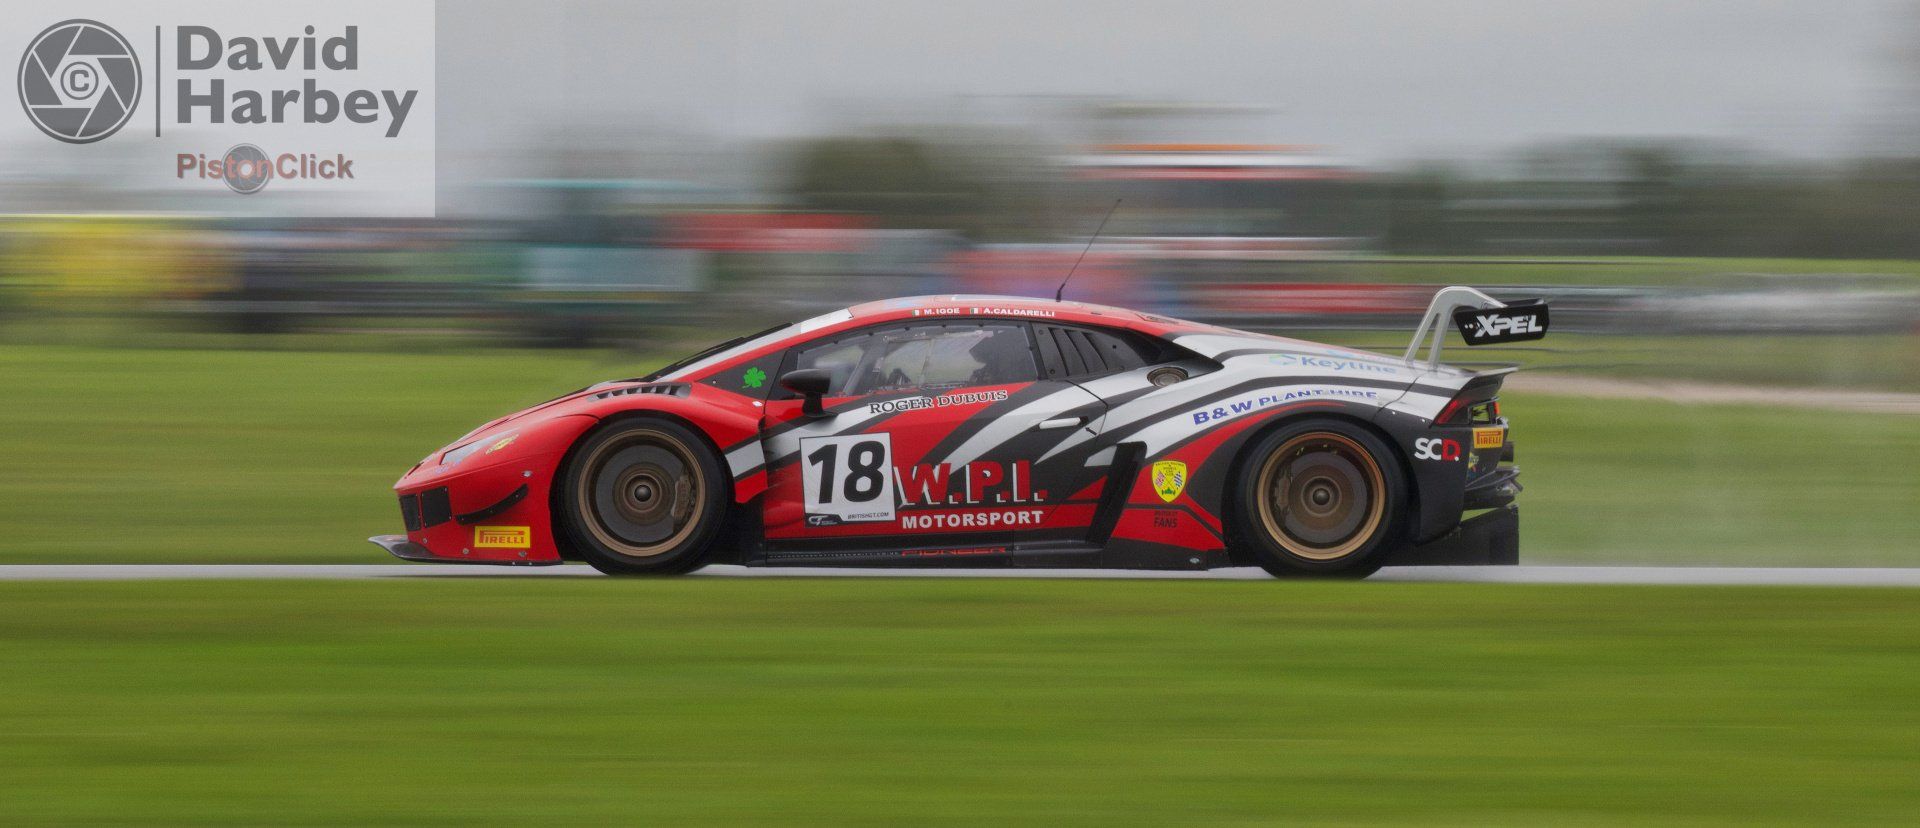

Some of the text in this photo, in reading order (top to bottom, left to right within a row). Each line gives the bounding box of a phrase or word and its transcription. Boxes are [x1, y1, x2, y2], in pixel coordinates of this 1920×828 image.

[1474, 314, 1543, 338] XPEL
[1302, 357, 1397, 374] Keyline
[869, 390, 1008, 414] ROGER DUBUIS
[1193, 389, 1377, 425] B&W PLANT HIRE
[1476, 431, 1502, 445] PIRELLI
[807, 440, 886, 505] 18
[893, 460, 1048, 507] W.P.I.
[902, 510, 1044, 529] MOTORSPORT
[479, 530, 525, 544] PIRELLI
